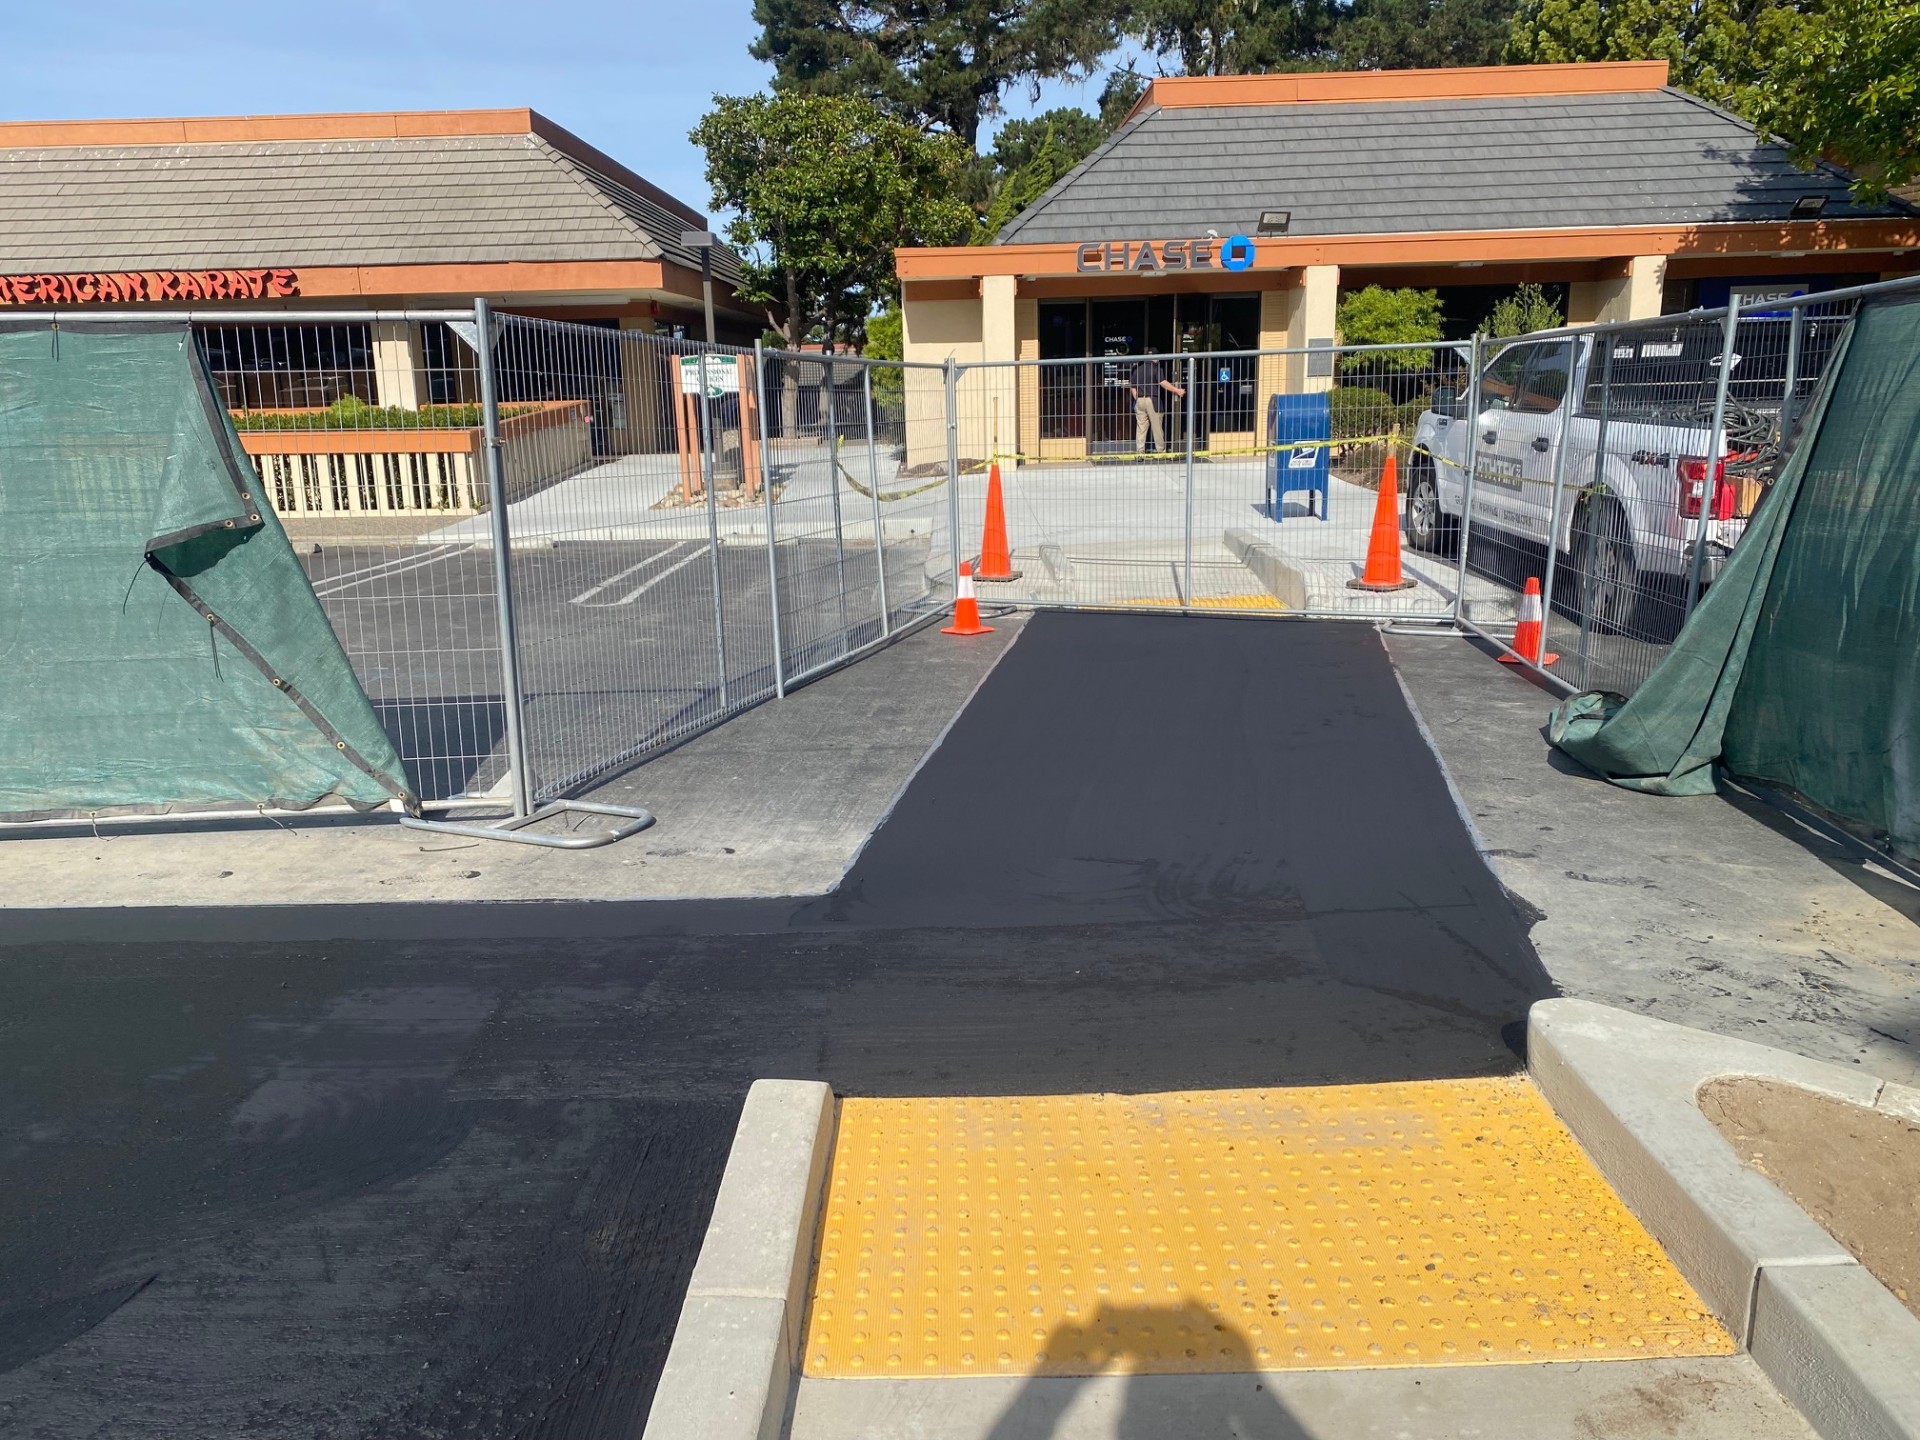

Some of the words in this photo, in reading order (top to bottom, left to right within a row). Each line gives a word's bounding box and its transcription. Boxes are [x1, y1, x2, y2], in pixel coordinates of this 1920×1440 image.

[1077, 241, 1213, 272] CHASE
[155, 268, 298, 298] KARATE
[1739, 292, 1788, 306] HASE
[685, 368, 733, 376] PROSSIONAL
